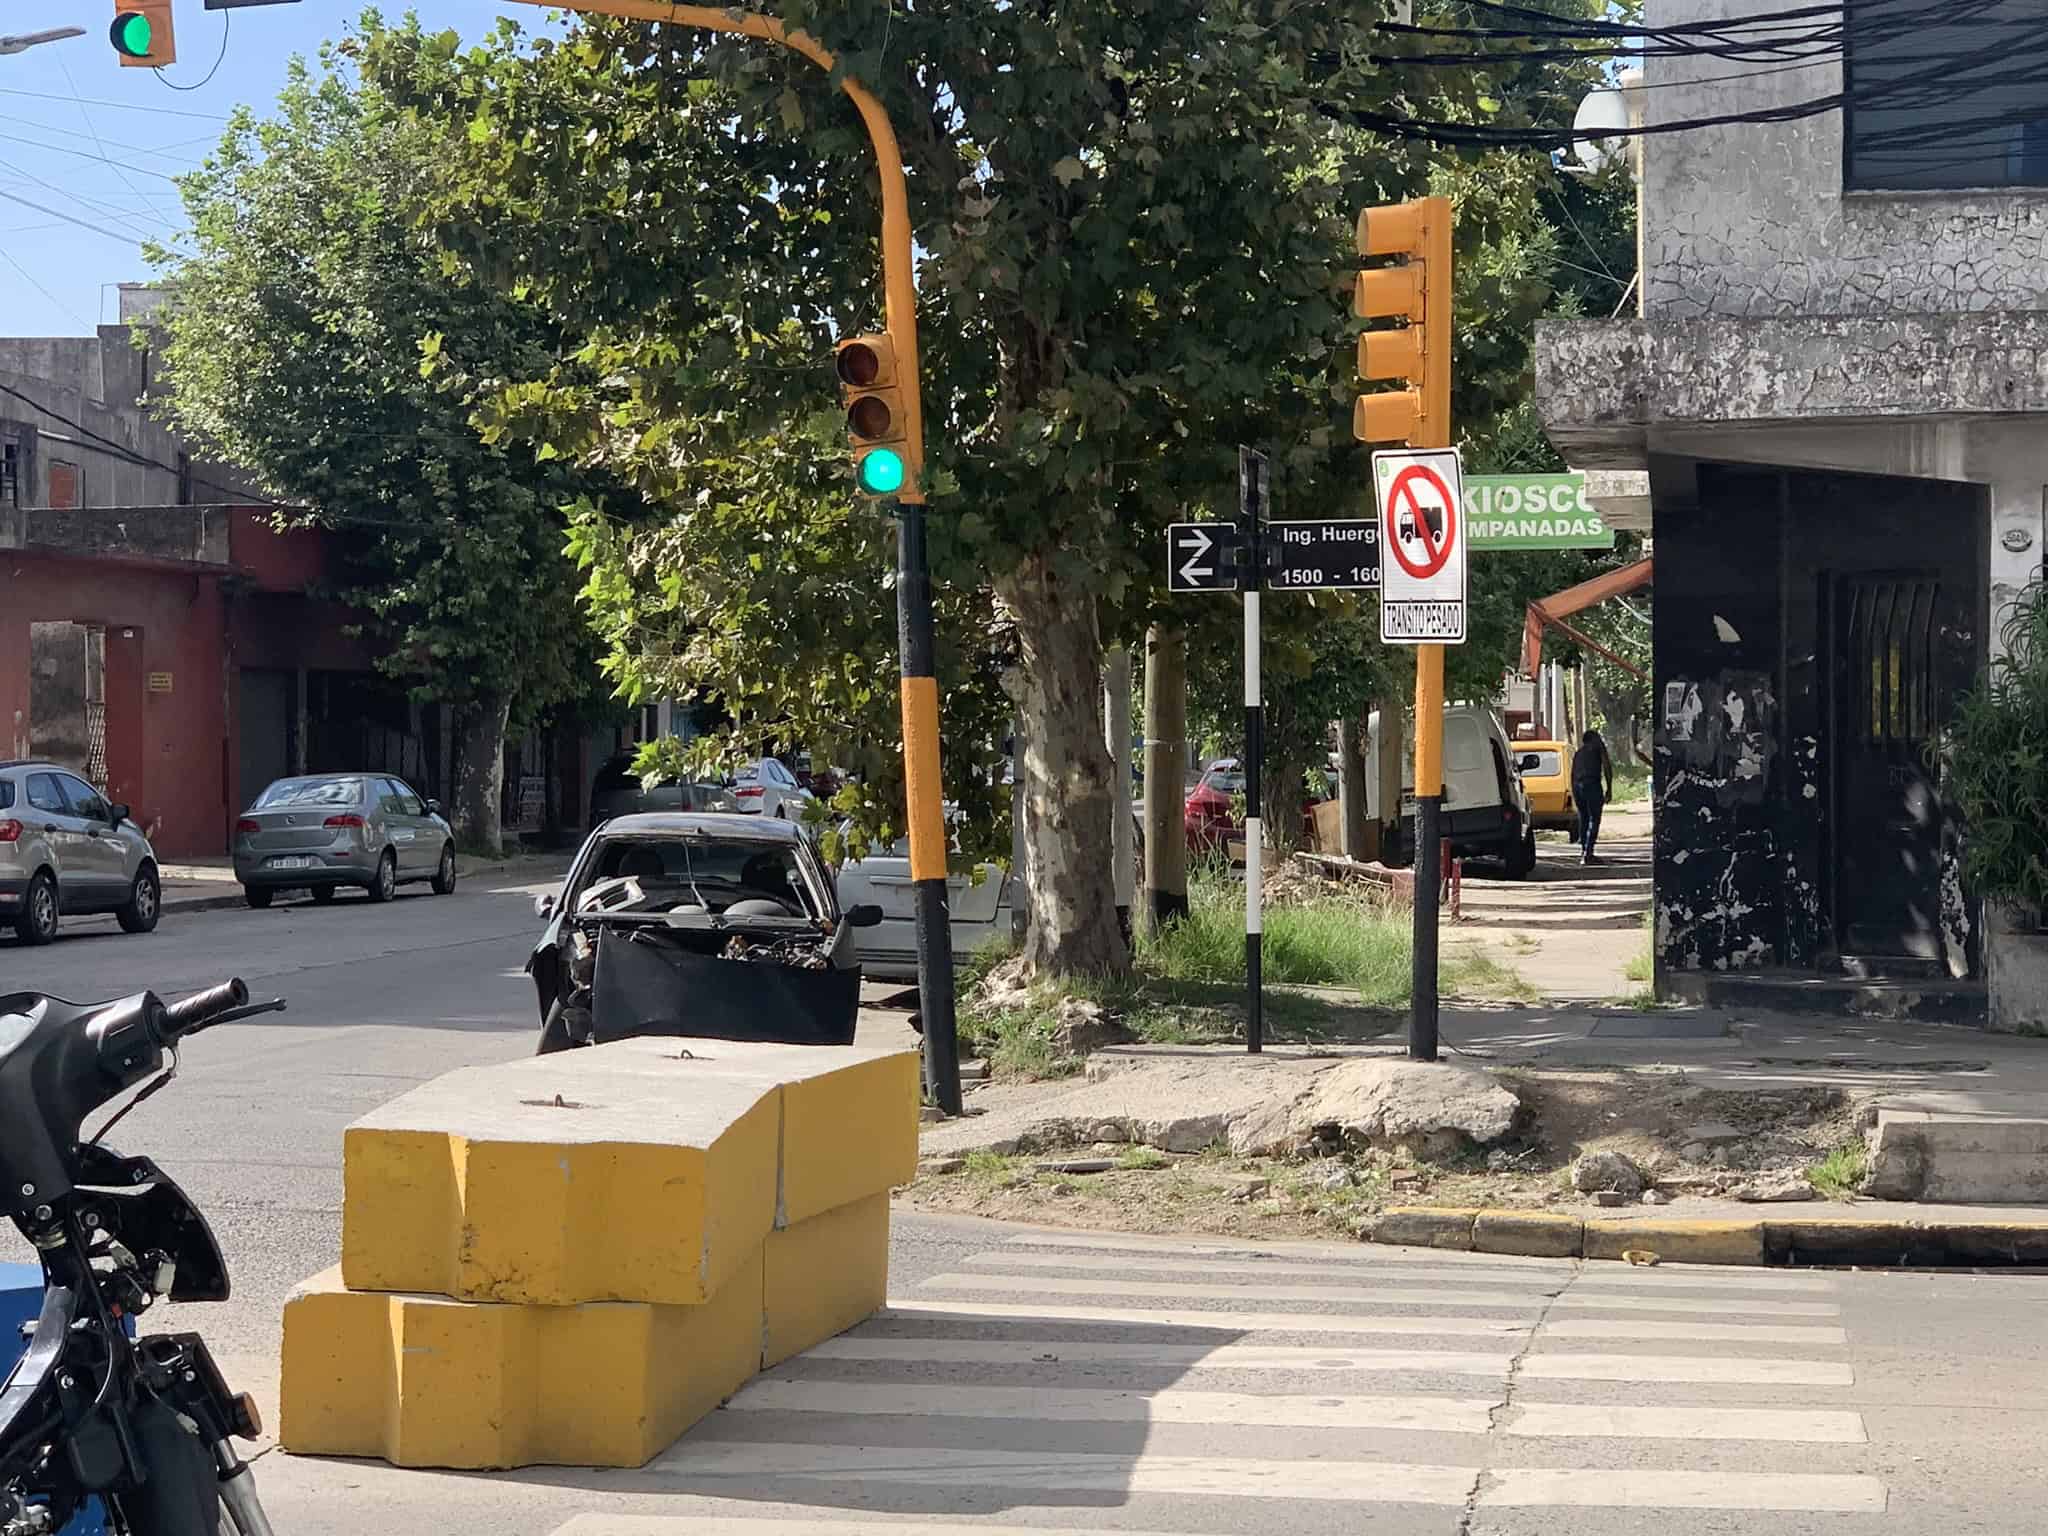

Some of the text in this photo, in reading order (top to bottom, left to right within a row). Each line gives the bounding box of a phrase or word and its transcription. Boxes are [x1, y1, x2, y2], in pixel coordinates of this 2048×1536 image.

[1283, 526, 1379, 546] Ing. Huerg
[1468, 518, 1603, 537] MPANADAS
[1281, 568, 1323, 584] 1500
[1350, 566, 1380, 582] 160
[1426, 604, 1460, 633] PESADO
